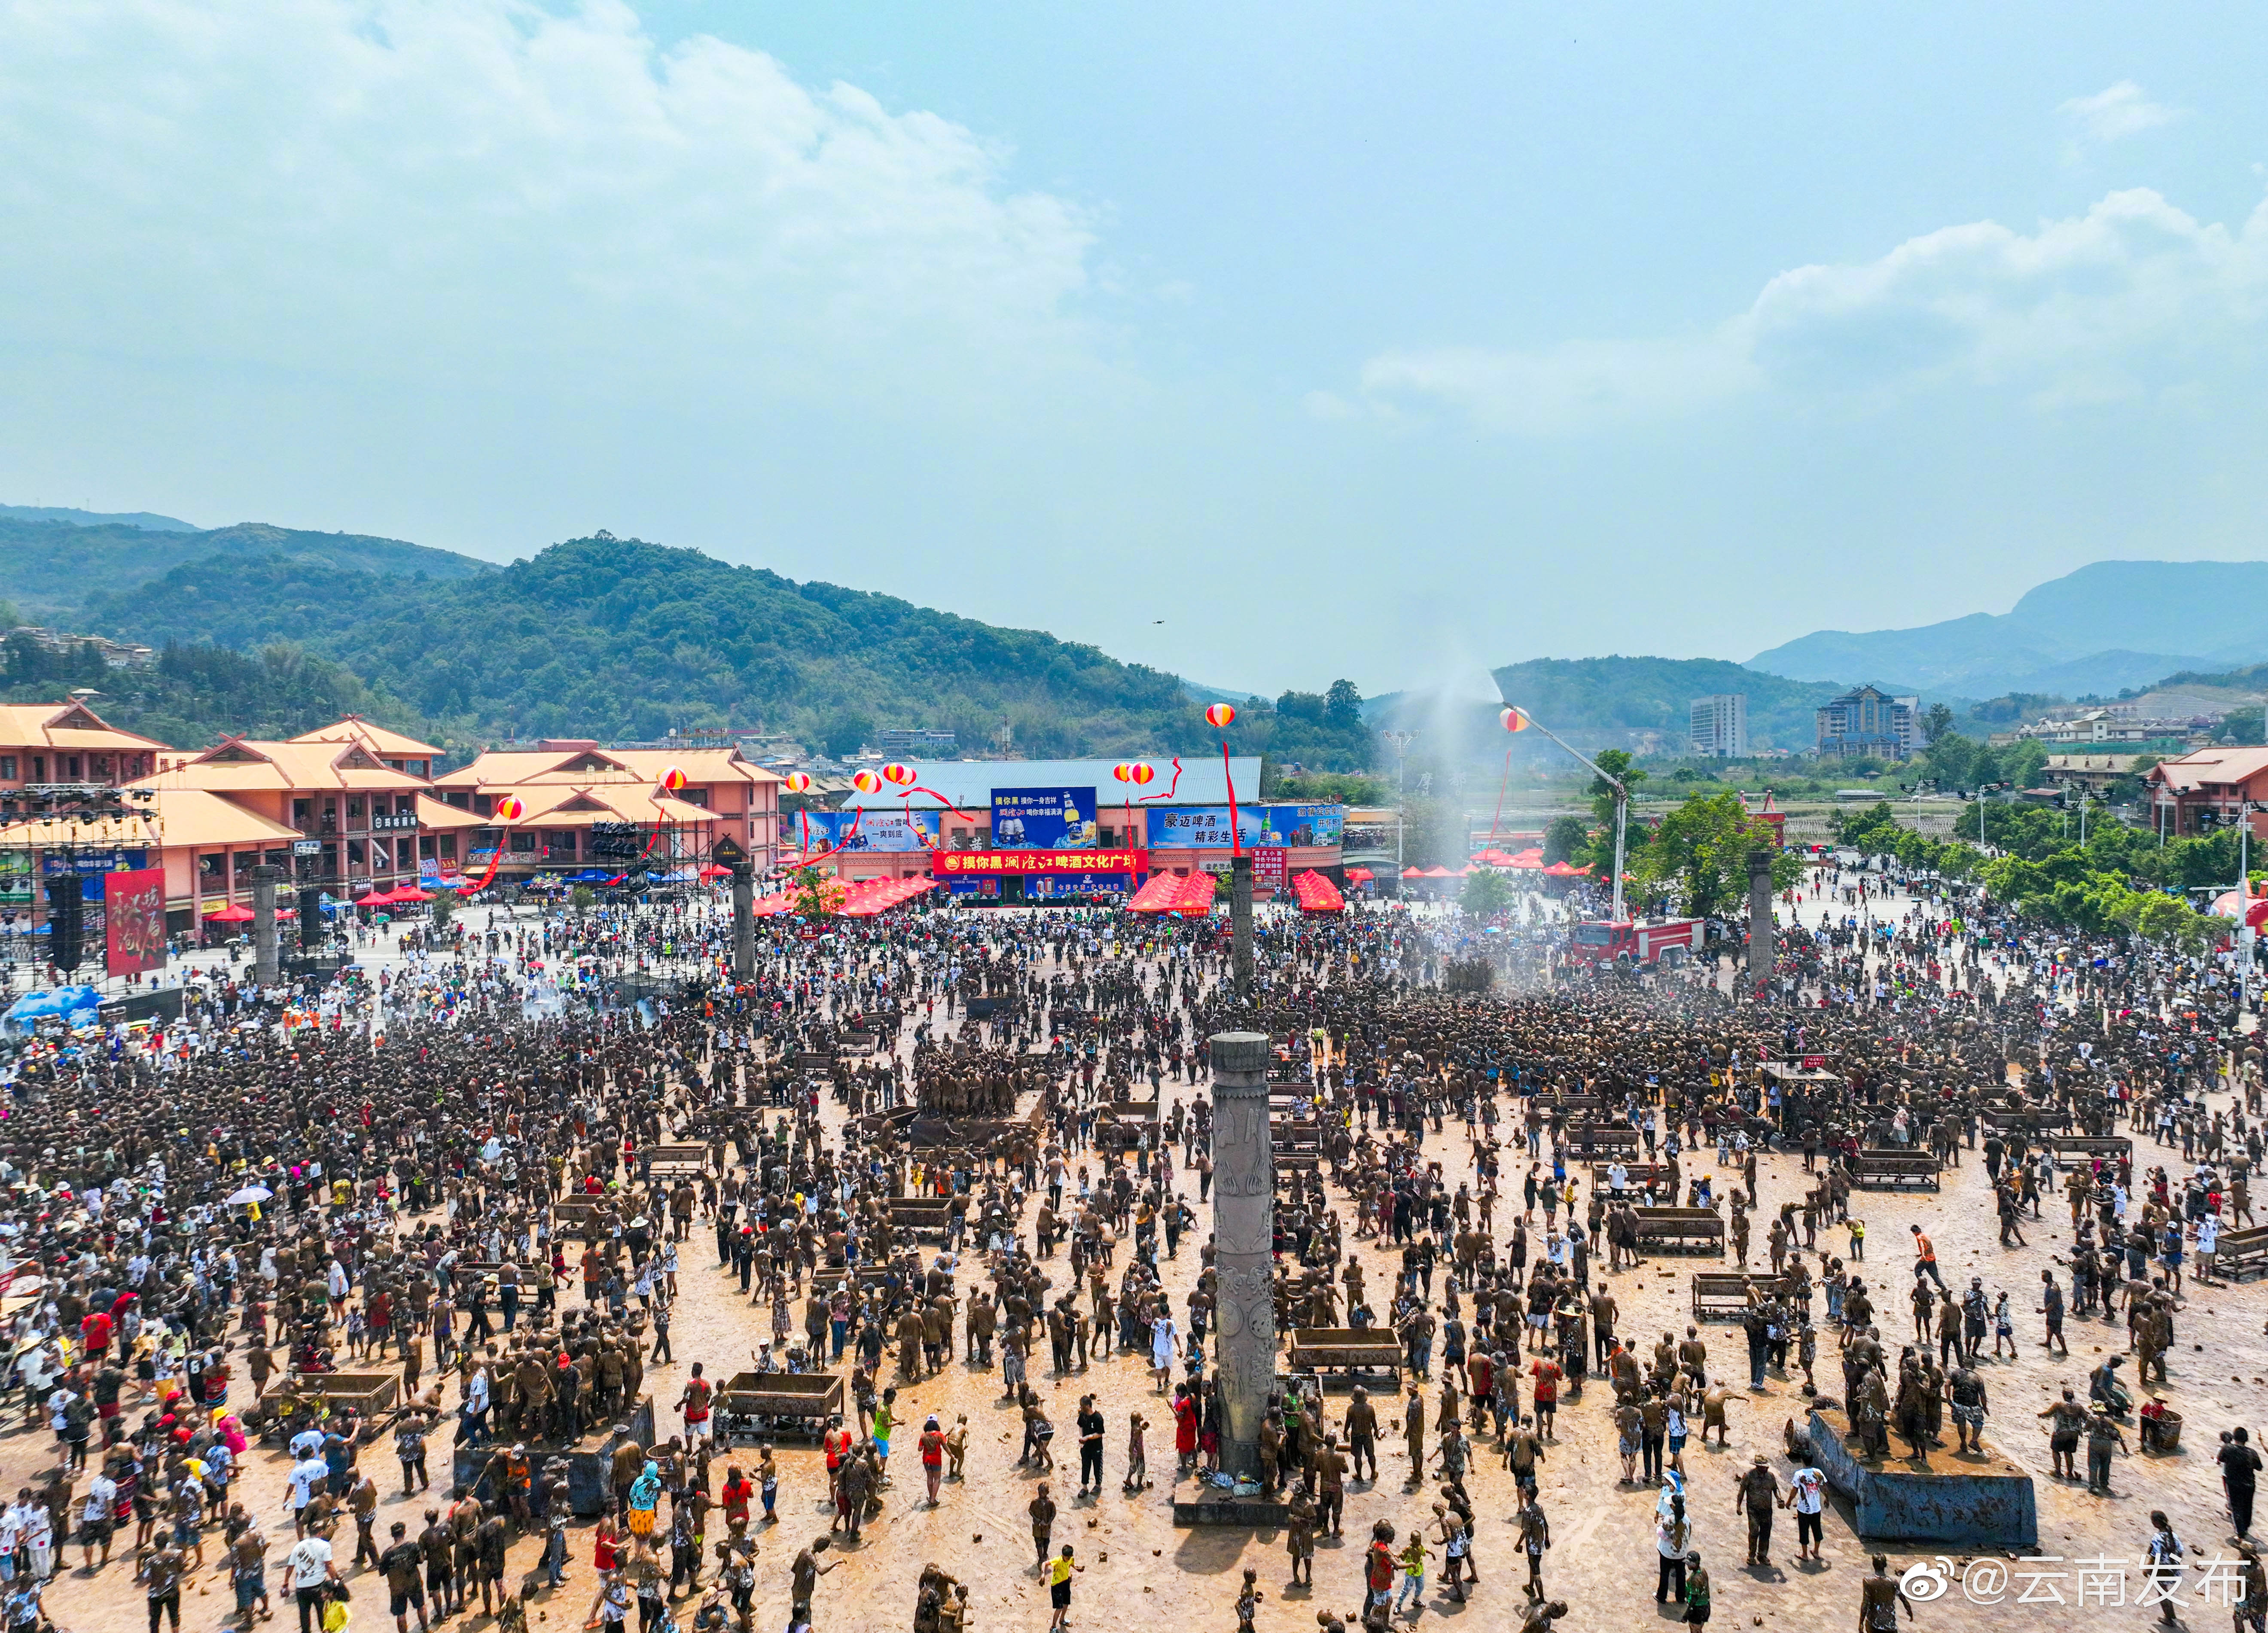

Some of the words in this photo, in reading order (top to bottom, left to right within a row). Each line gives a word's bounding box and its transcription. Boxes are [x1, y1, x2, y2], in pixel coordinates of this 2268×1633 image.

[995, 797, 1018, 805] 摸你黑
[1021, 796, 1057, 804] 摸你一身吉祥
[999, 808, 1025, 816] 澜沧江
[385, 816, 416, 827] 玛格丽特
[1164, 813, 1216, 828] 豪迈啤酒
[872, 830, 903, 838] 一爽到底
[1195, 828, 1247, 843] 精彩生活
[963, 854, 1136, 869] 摸你黑澜沧江啤酒文化广场
